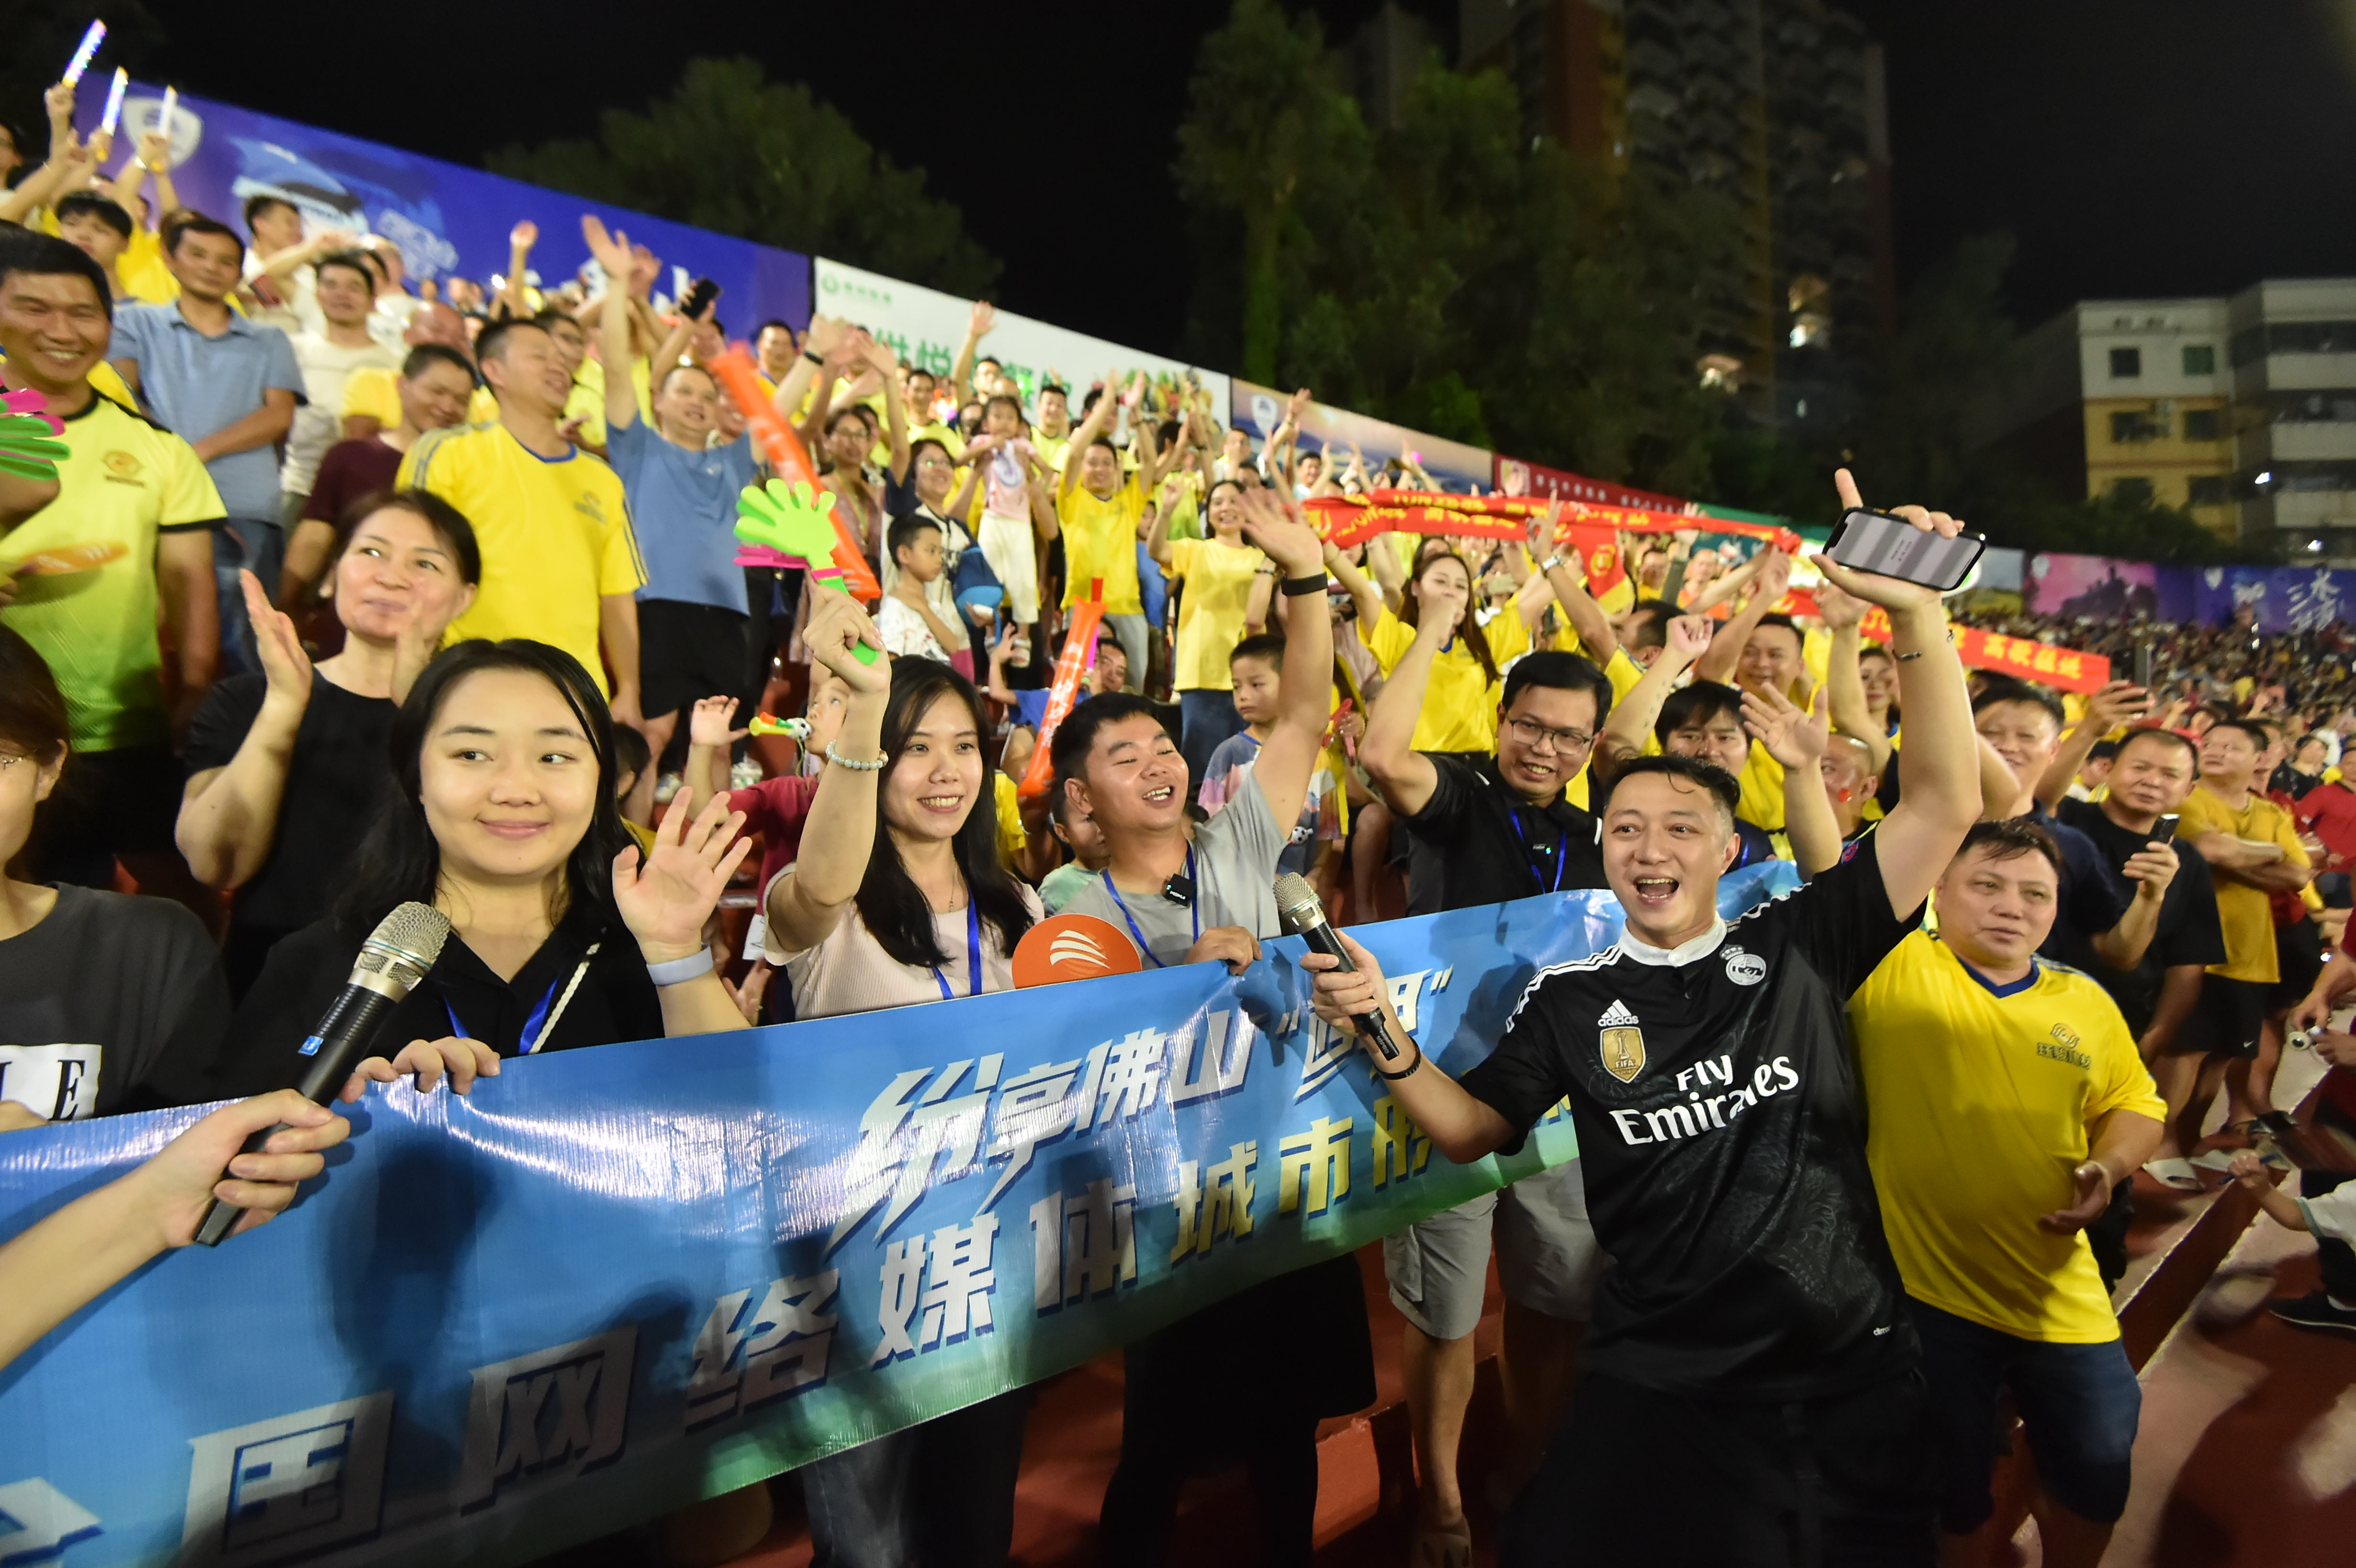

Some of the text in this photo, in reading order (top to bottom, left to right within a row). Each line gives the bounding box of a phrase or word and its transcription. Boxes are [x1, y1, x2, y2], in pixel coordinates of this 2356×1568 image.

[1598, 1015, 1639, 1026] adidas
[1615, 1059, 1634, 1068] FIFA
[1676, 1055, 1733, 1091] Fly
[0, 1068, 1572, 1568] 国网络媒体城市形
